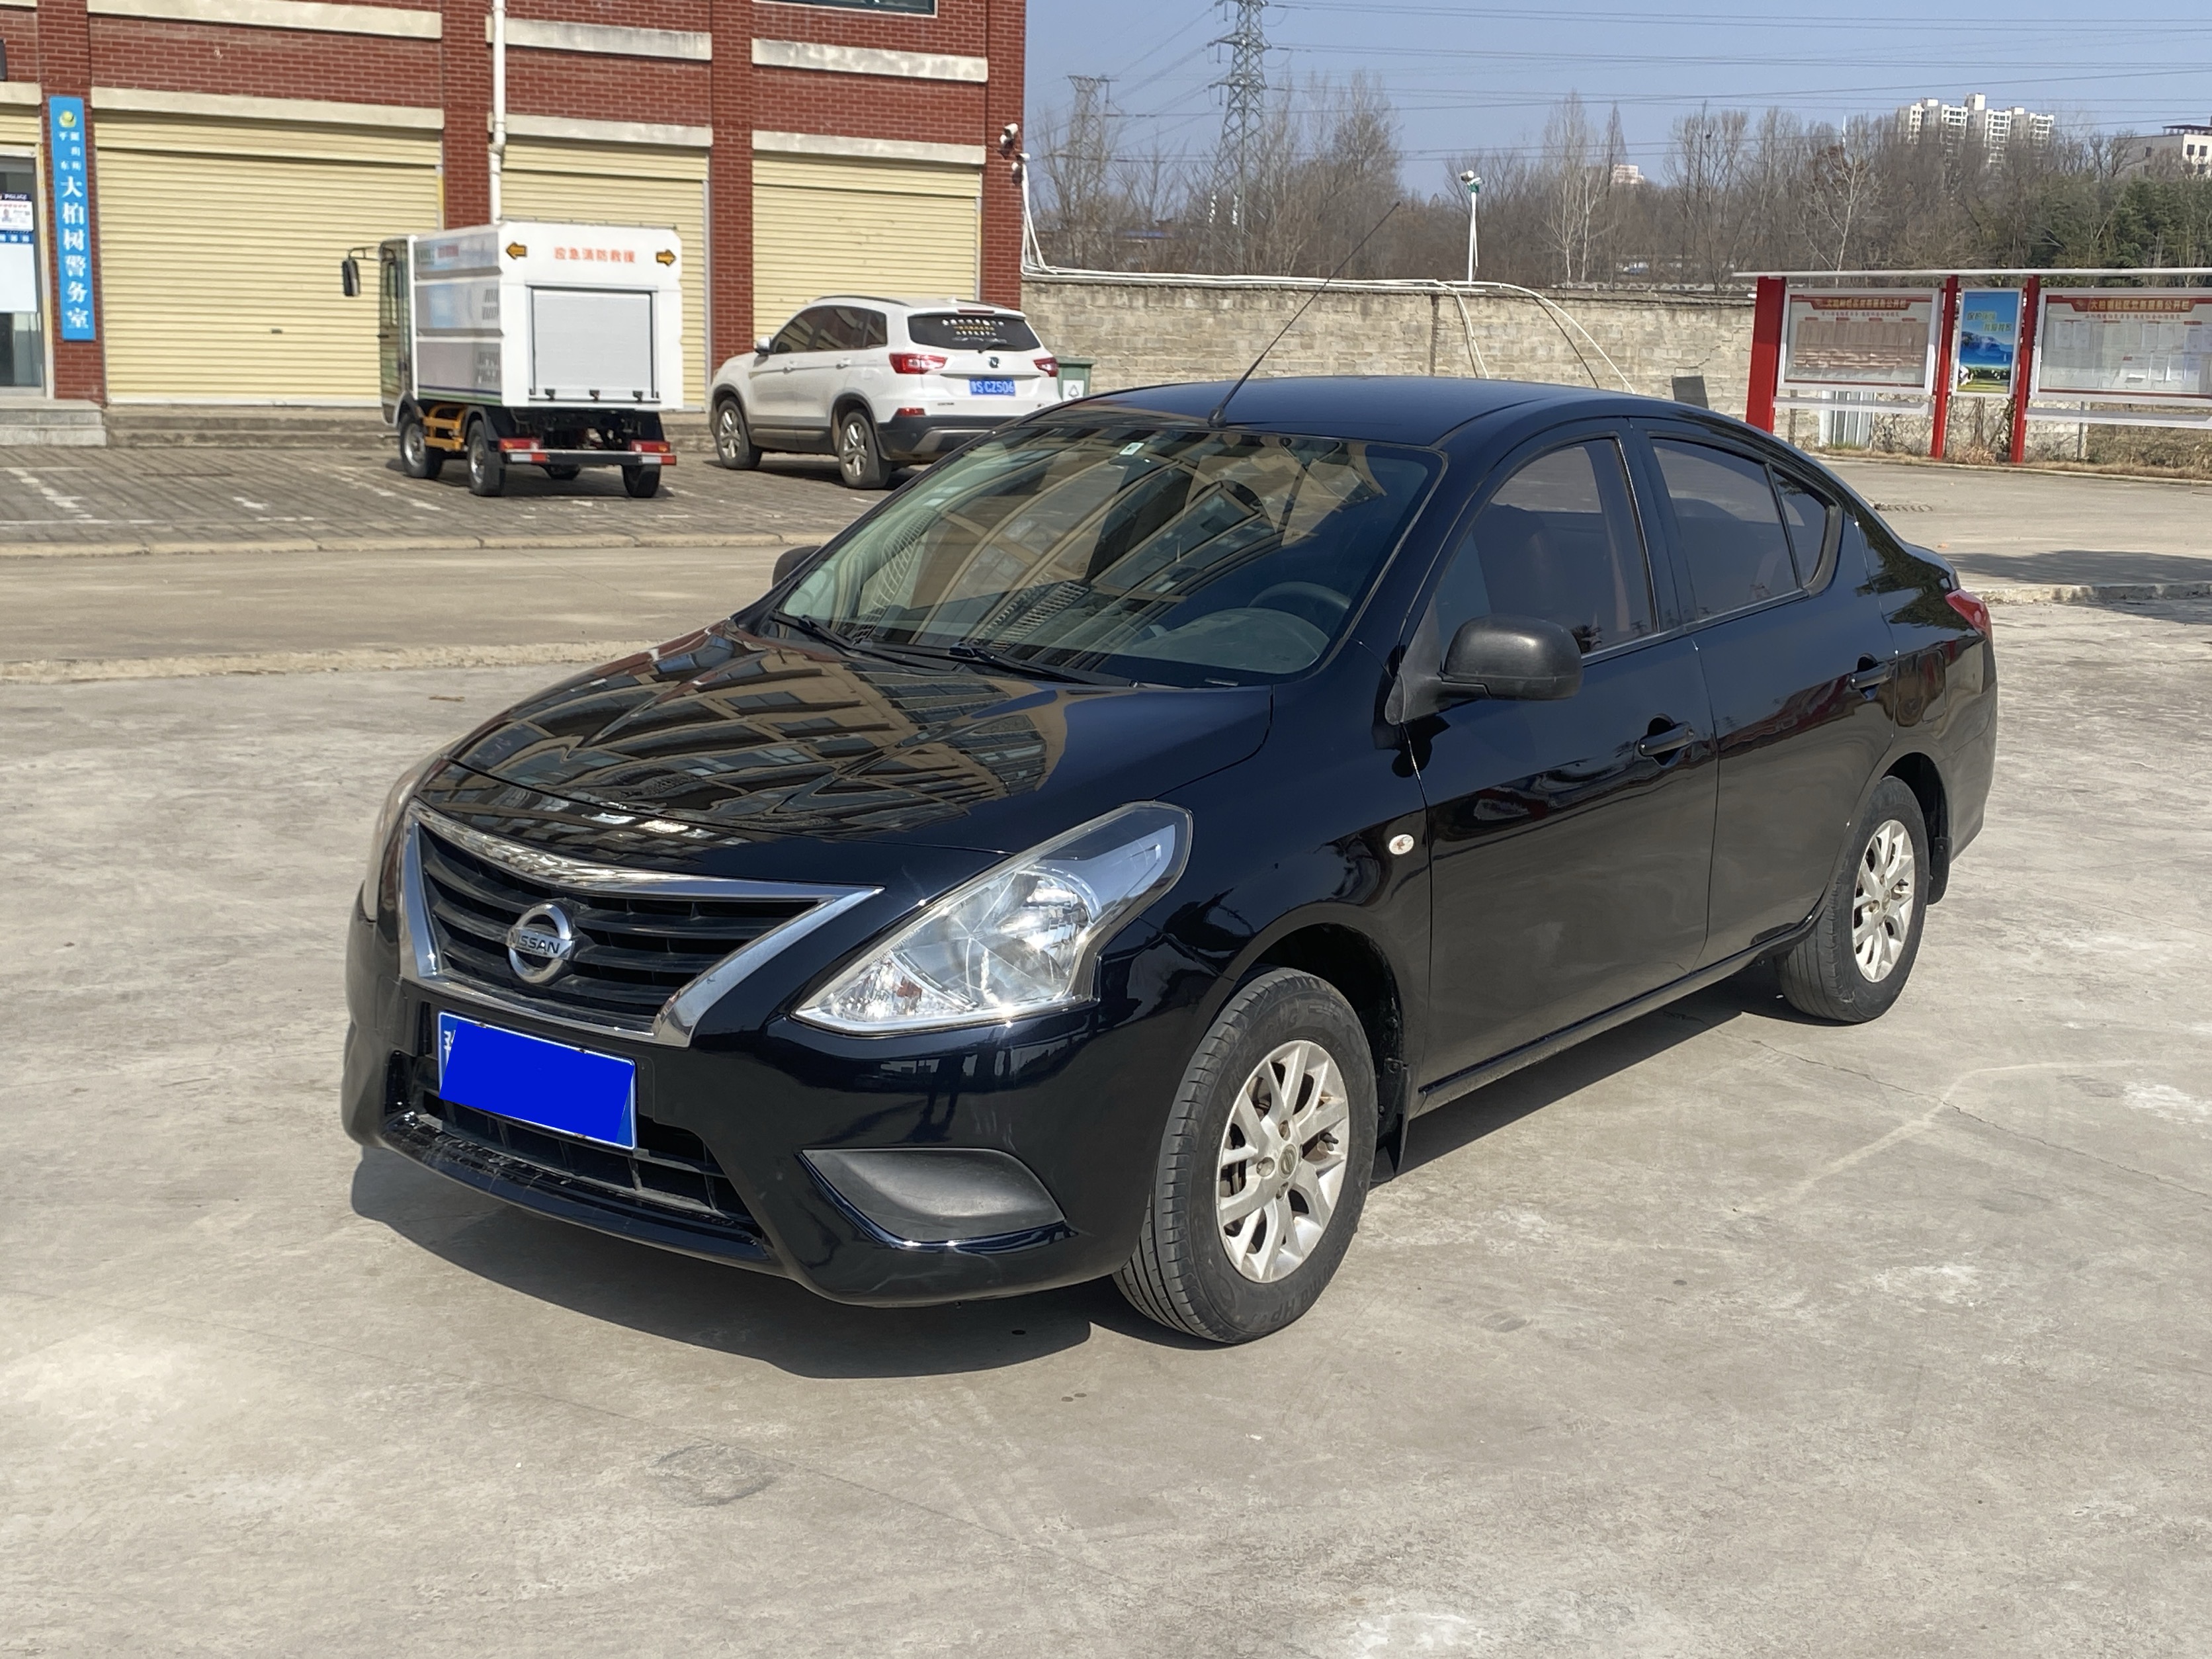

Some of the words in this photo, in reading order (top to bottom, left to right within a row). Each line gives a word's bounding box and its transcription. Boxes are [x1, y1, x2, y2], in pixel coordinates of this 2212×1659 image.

[60, 176, 89, 329] 大柏树警务室
[509, 931, 560, 954] NISSAN
